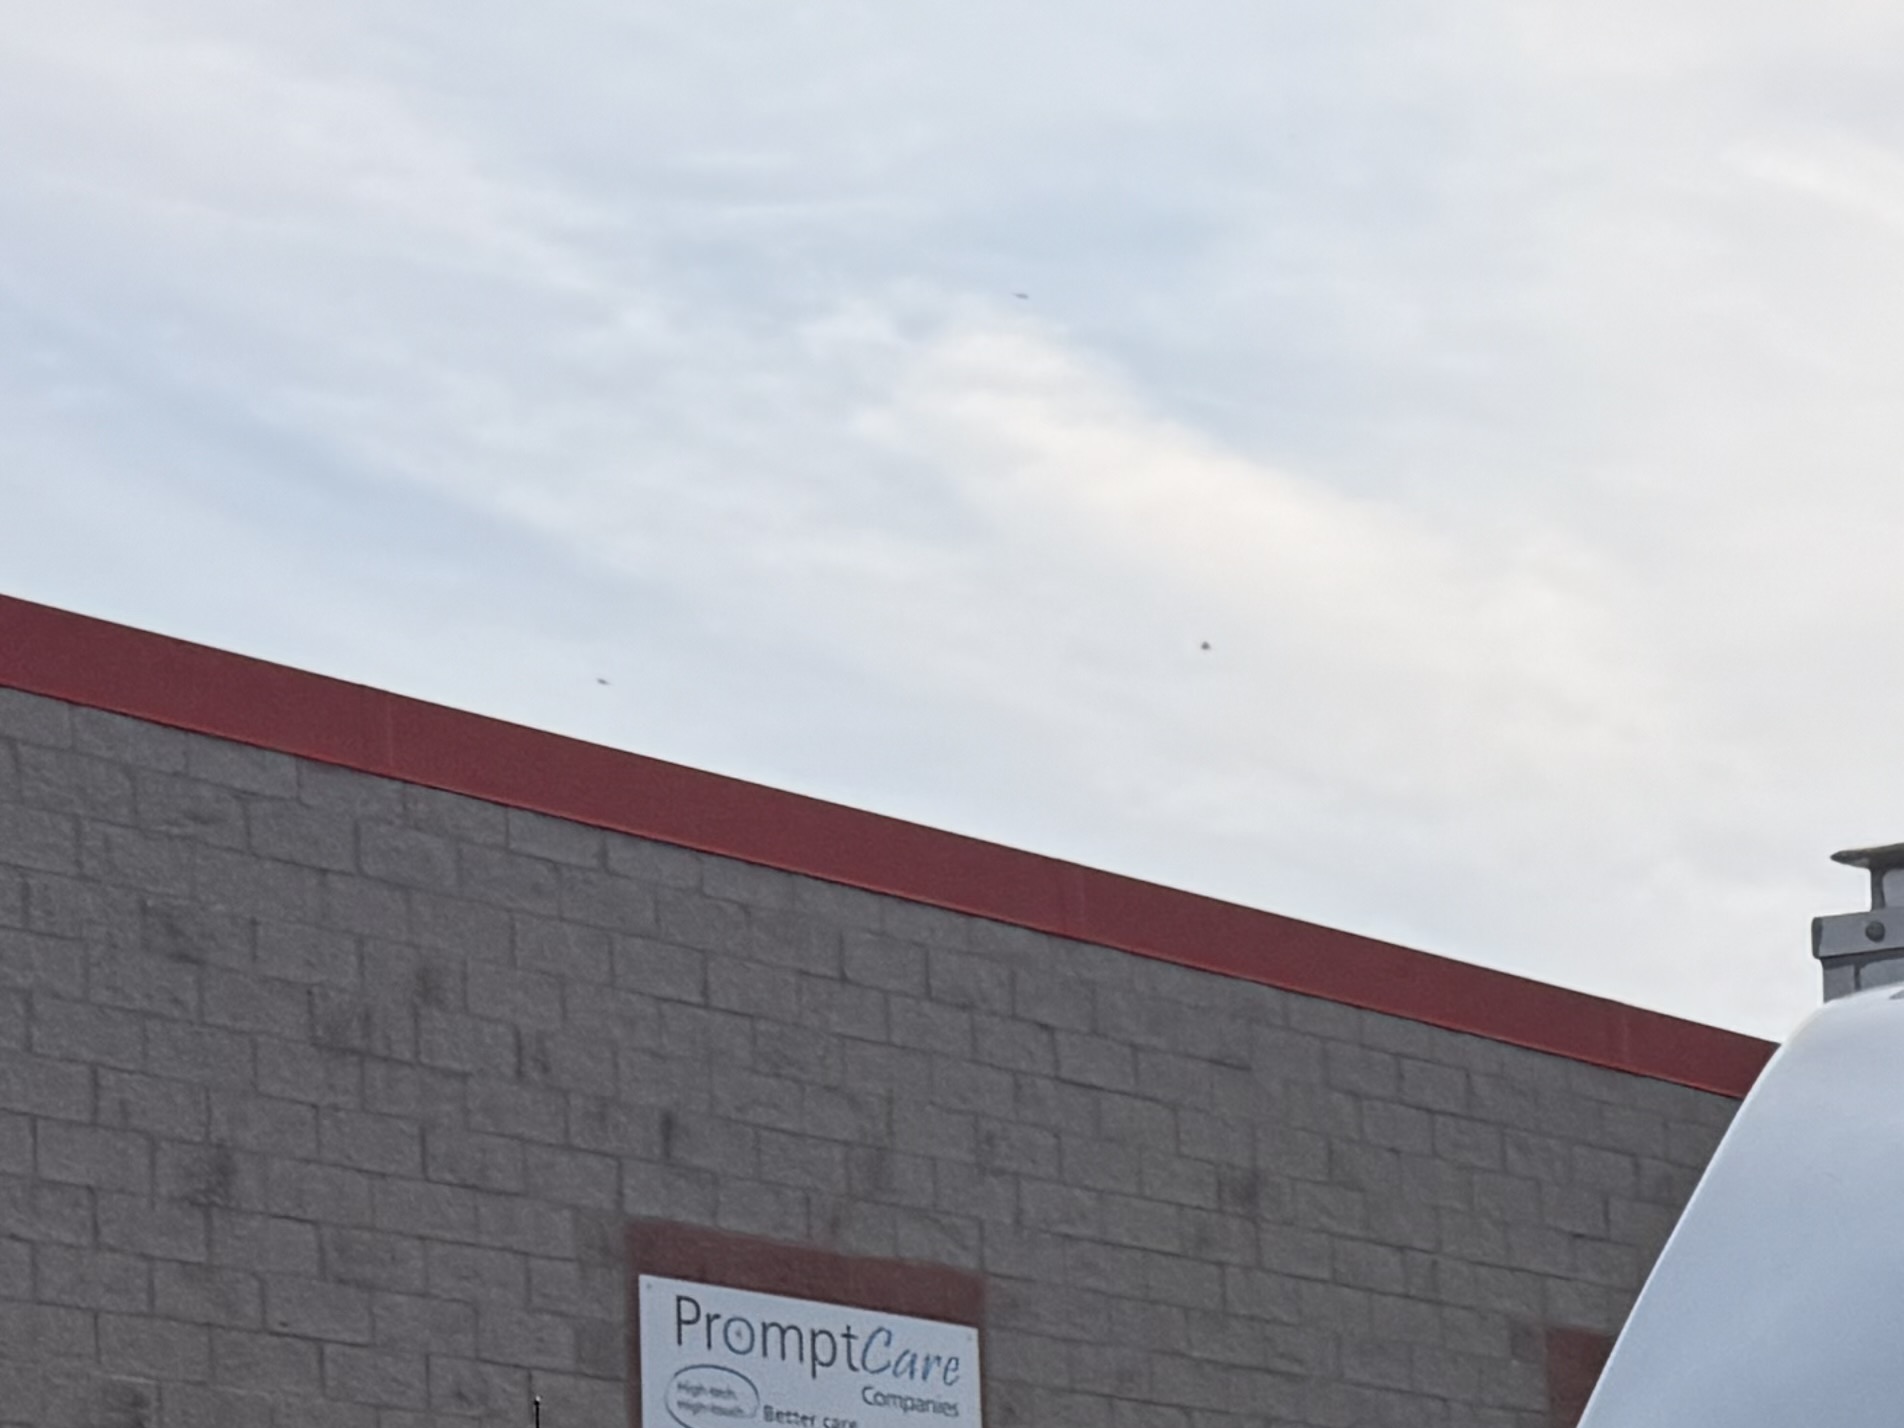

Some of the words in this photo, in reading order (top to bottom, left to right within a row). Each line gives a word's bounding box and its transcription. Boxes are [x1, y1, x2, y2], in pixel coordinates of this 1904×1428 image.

[675, 1294, 960, 1387] PromptCare
[763, 1404, 817, 1428] Better
[862, 1386, 960, 1417] Companies
